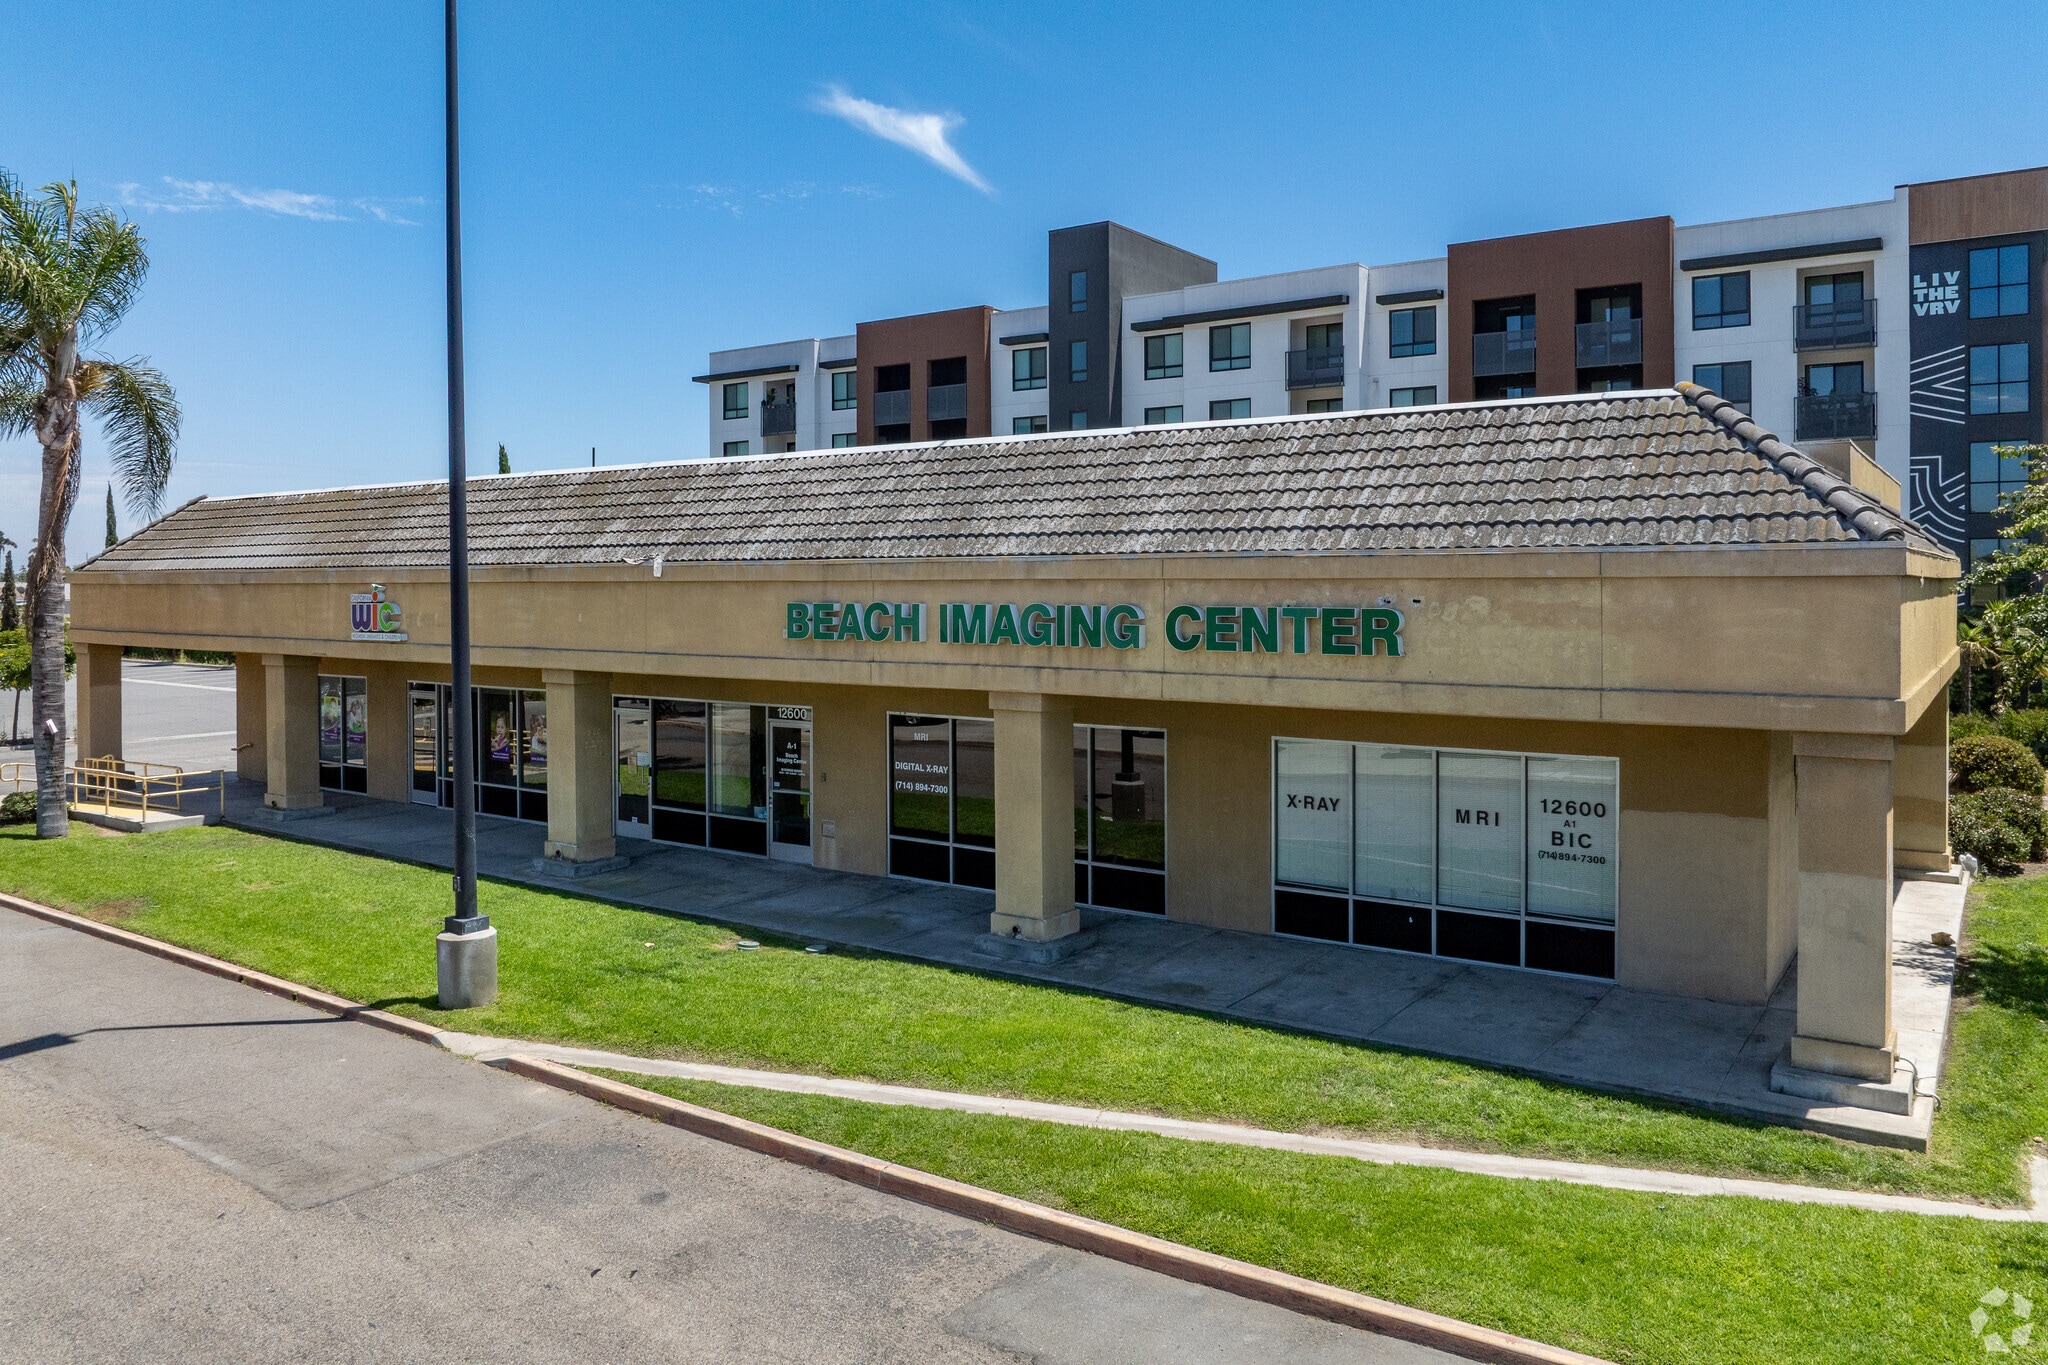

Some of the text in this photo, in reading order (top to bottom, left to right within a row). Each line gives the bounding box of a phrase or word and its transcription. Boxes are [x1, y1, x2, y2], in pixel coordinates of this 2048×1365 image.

[1913, 271, 1960, 288] LIV
[1913, 286, 1959, 302] THE
[1913, 300, 1960, 316] VRV
[786, 602, 1405, 657] BEACH IMAGING CENTER
[777, 708, 808, 720] 12600
[913, 732, 929, 742] MRI
[895, 761, 949, 774] DIGITAL X-RAY
[895, 780, 949, 794] (714) 894-7300
[1286, 794, 1340, 812] X-RAY
[1540, 798, 1606, 818] 12600
[1456, 808, 1500, 827] MRI
[1563, 819, 1577, 829] A1
[1551, 830, 1593, 849] BIC
